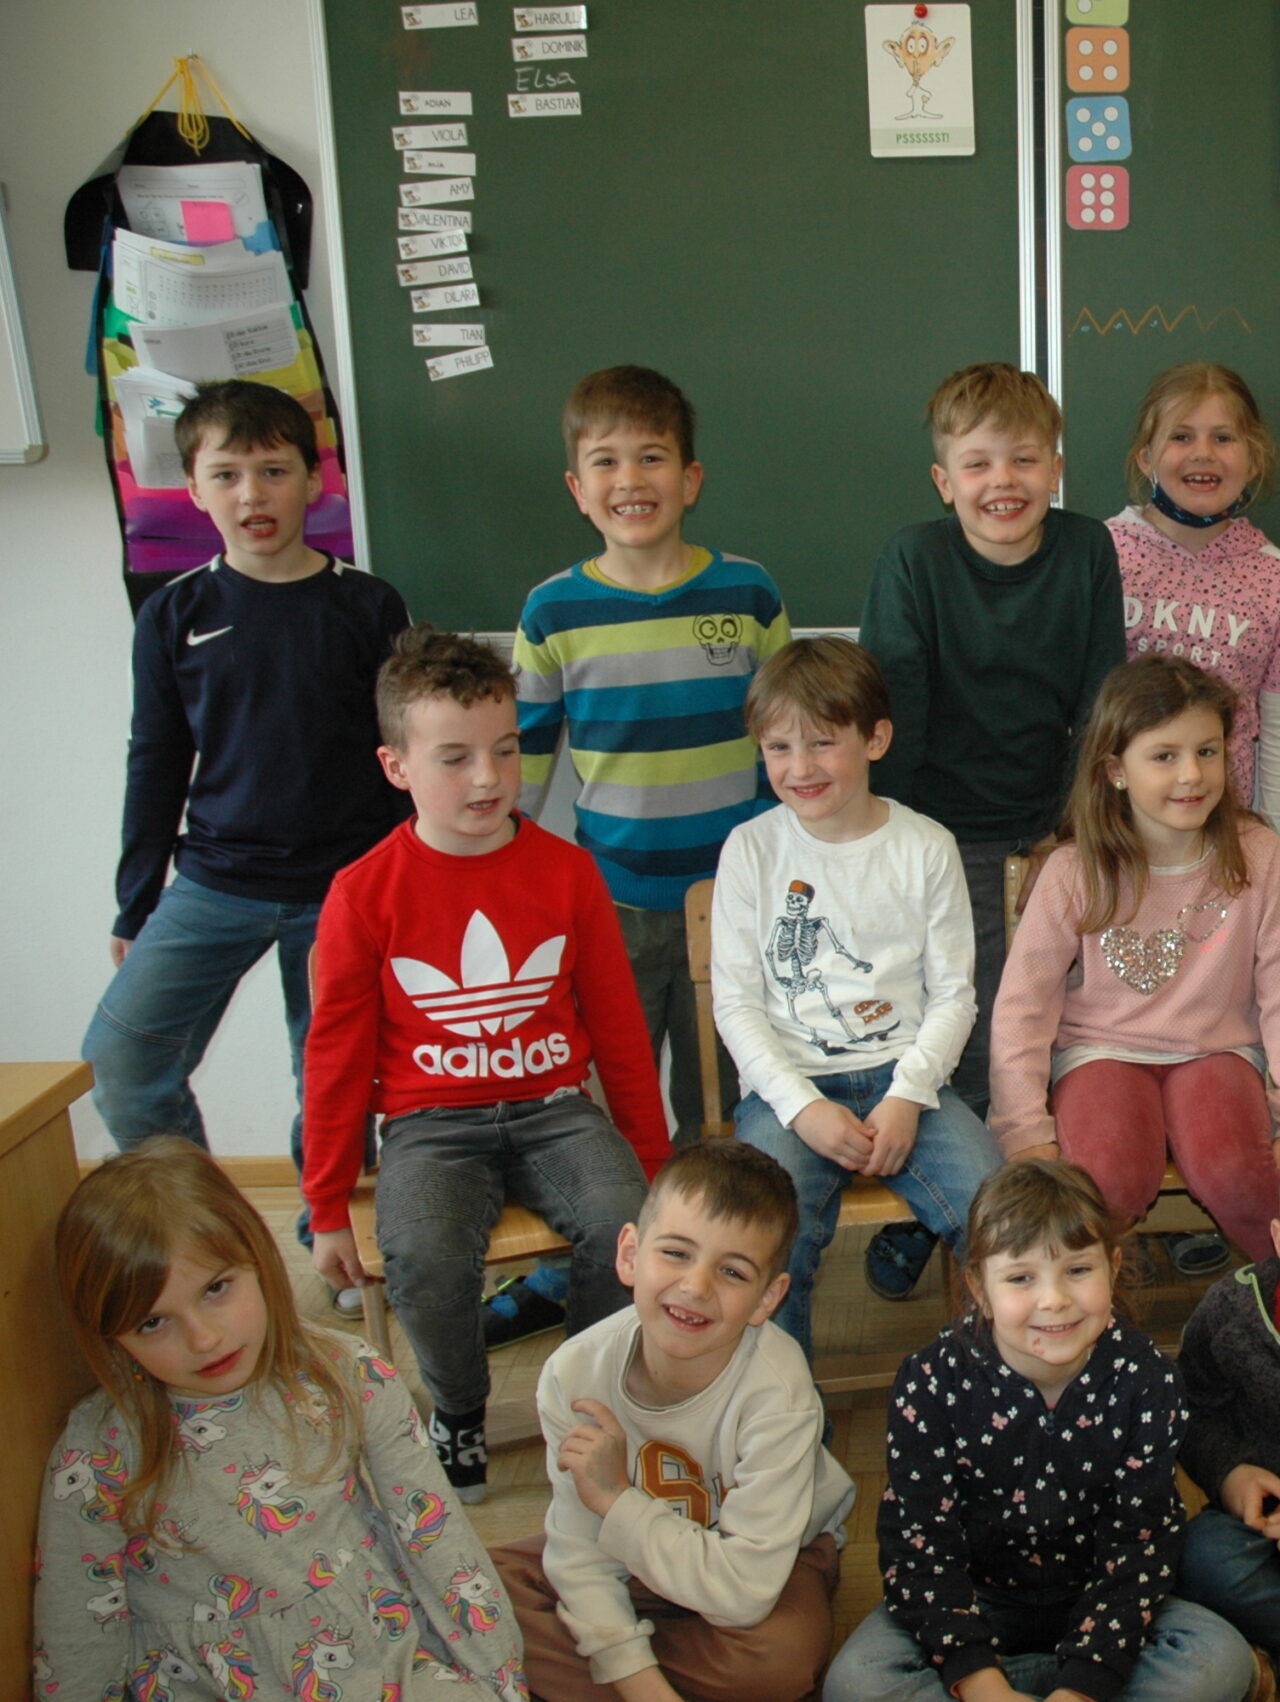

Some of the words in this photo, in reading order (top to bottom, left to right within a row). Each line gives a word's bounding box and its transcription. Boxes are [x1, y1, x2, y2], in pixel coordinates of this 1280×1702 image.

[453, 8, 476, 21] LEA
[541, 40, 586, 54] DOMINIK
[515, 67, 576, 92] Elsa
[535, 97, 580, 111] BASTIAN
[431, 129, 465, 142] VIOLA
[449, 184, 470, 195] AMY
[414, 215, 469, 227] VALENTINA
[438, 262, 470, 277] DAVID
[459, 328, 484, 341] TIAN
[454, 351, 489, 369] PHILIPP
[1123, 596, 1250, 647] DKNY
[1138, 638, 1221, 666] SPORT
[412, 1032, 571, 1078] adidas
